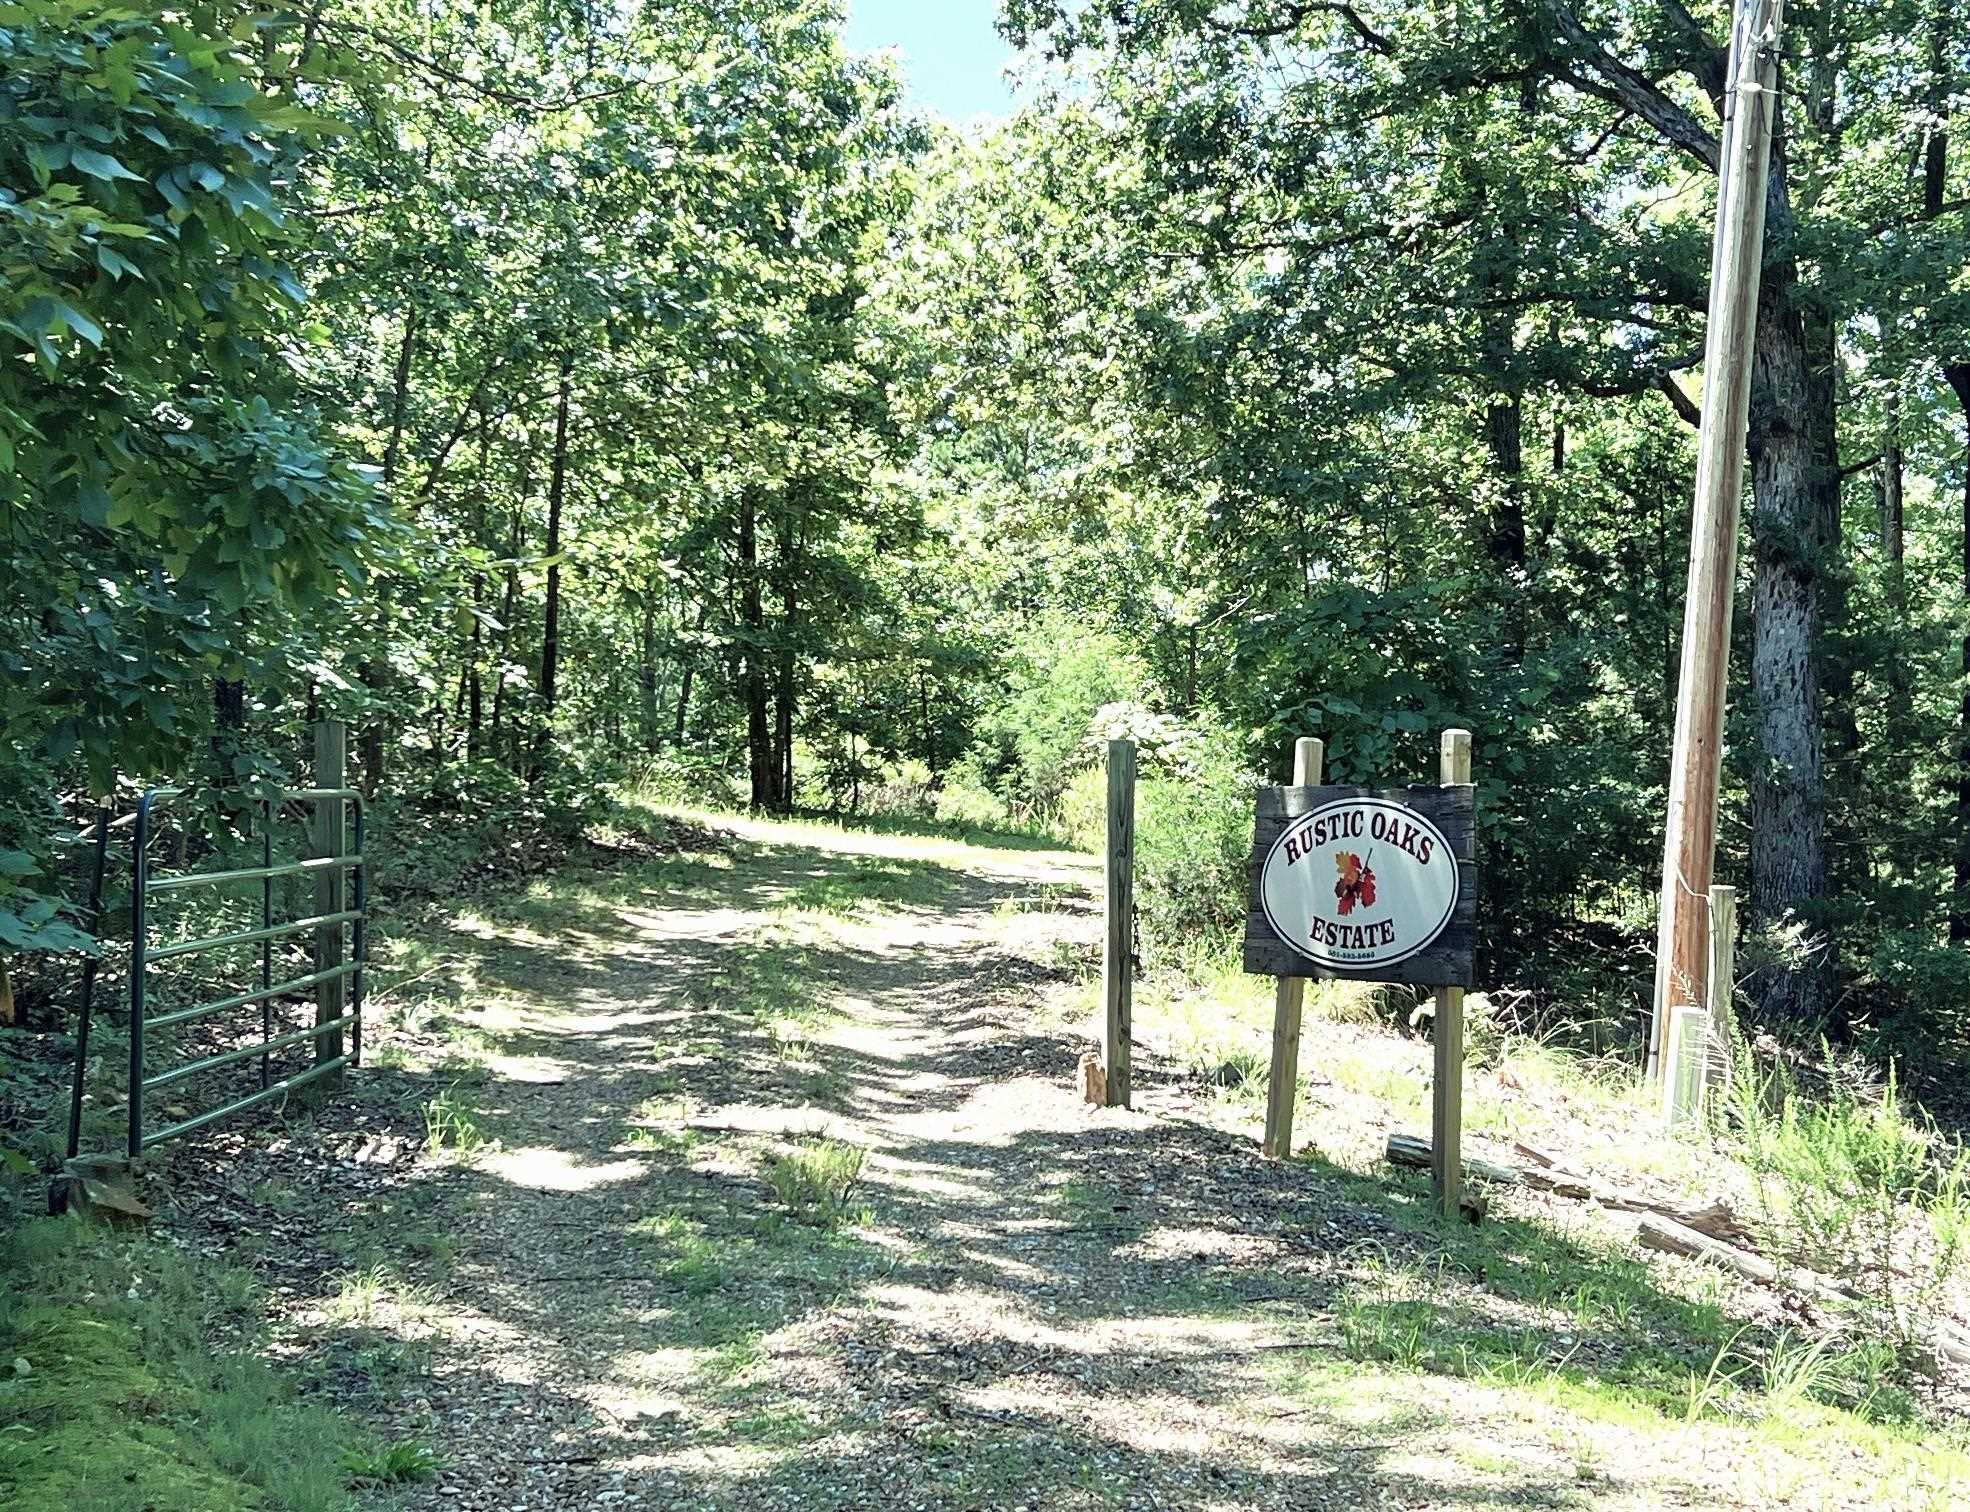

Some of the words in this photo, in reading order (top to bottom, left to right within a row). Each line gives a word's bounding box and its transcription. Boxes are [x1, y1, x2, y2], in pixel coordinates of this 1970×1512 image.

[1284, 810, 1364, 866] RUSTIC
[1371, 812, 1434, 865] OAKS
[1310, 916, 1395, 949] ESTATE
